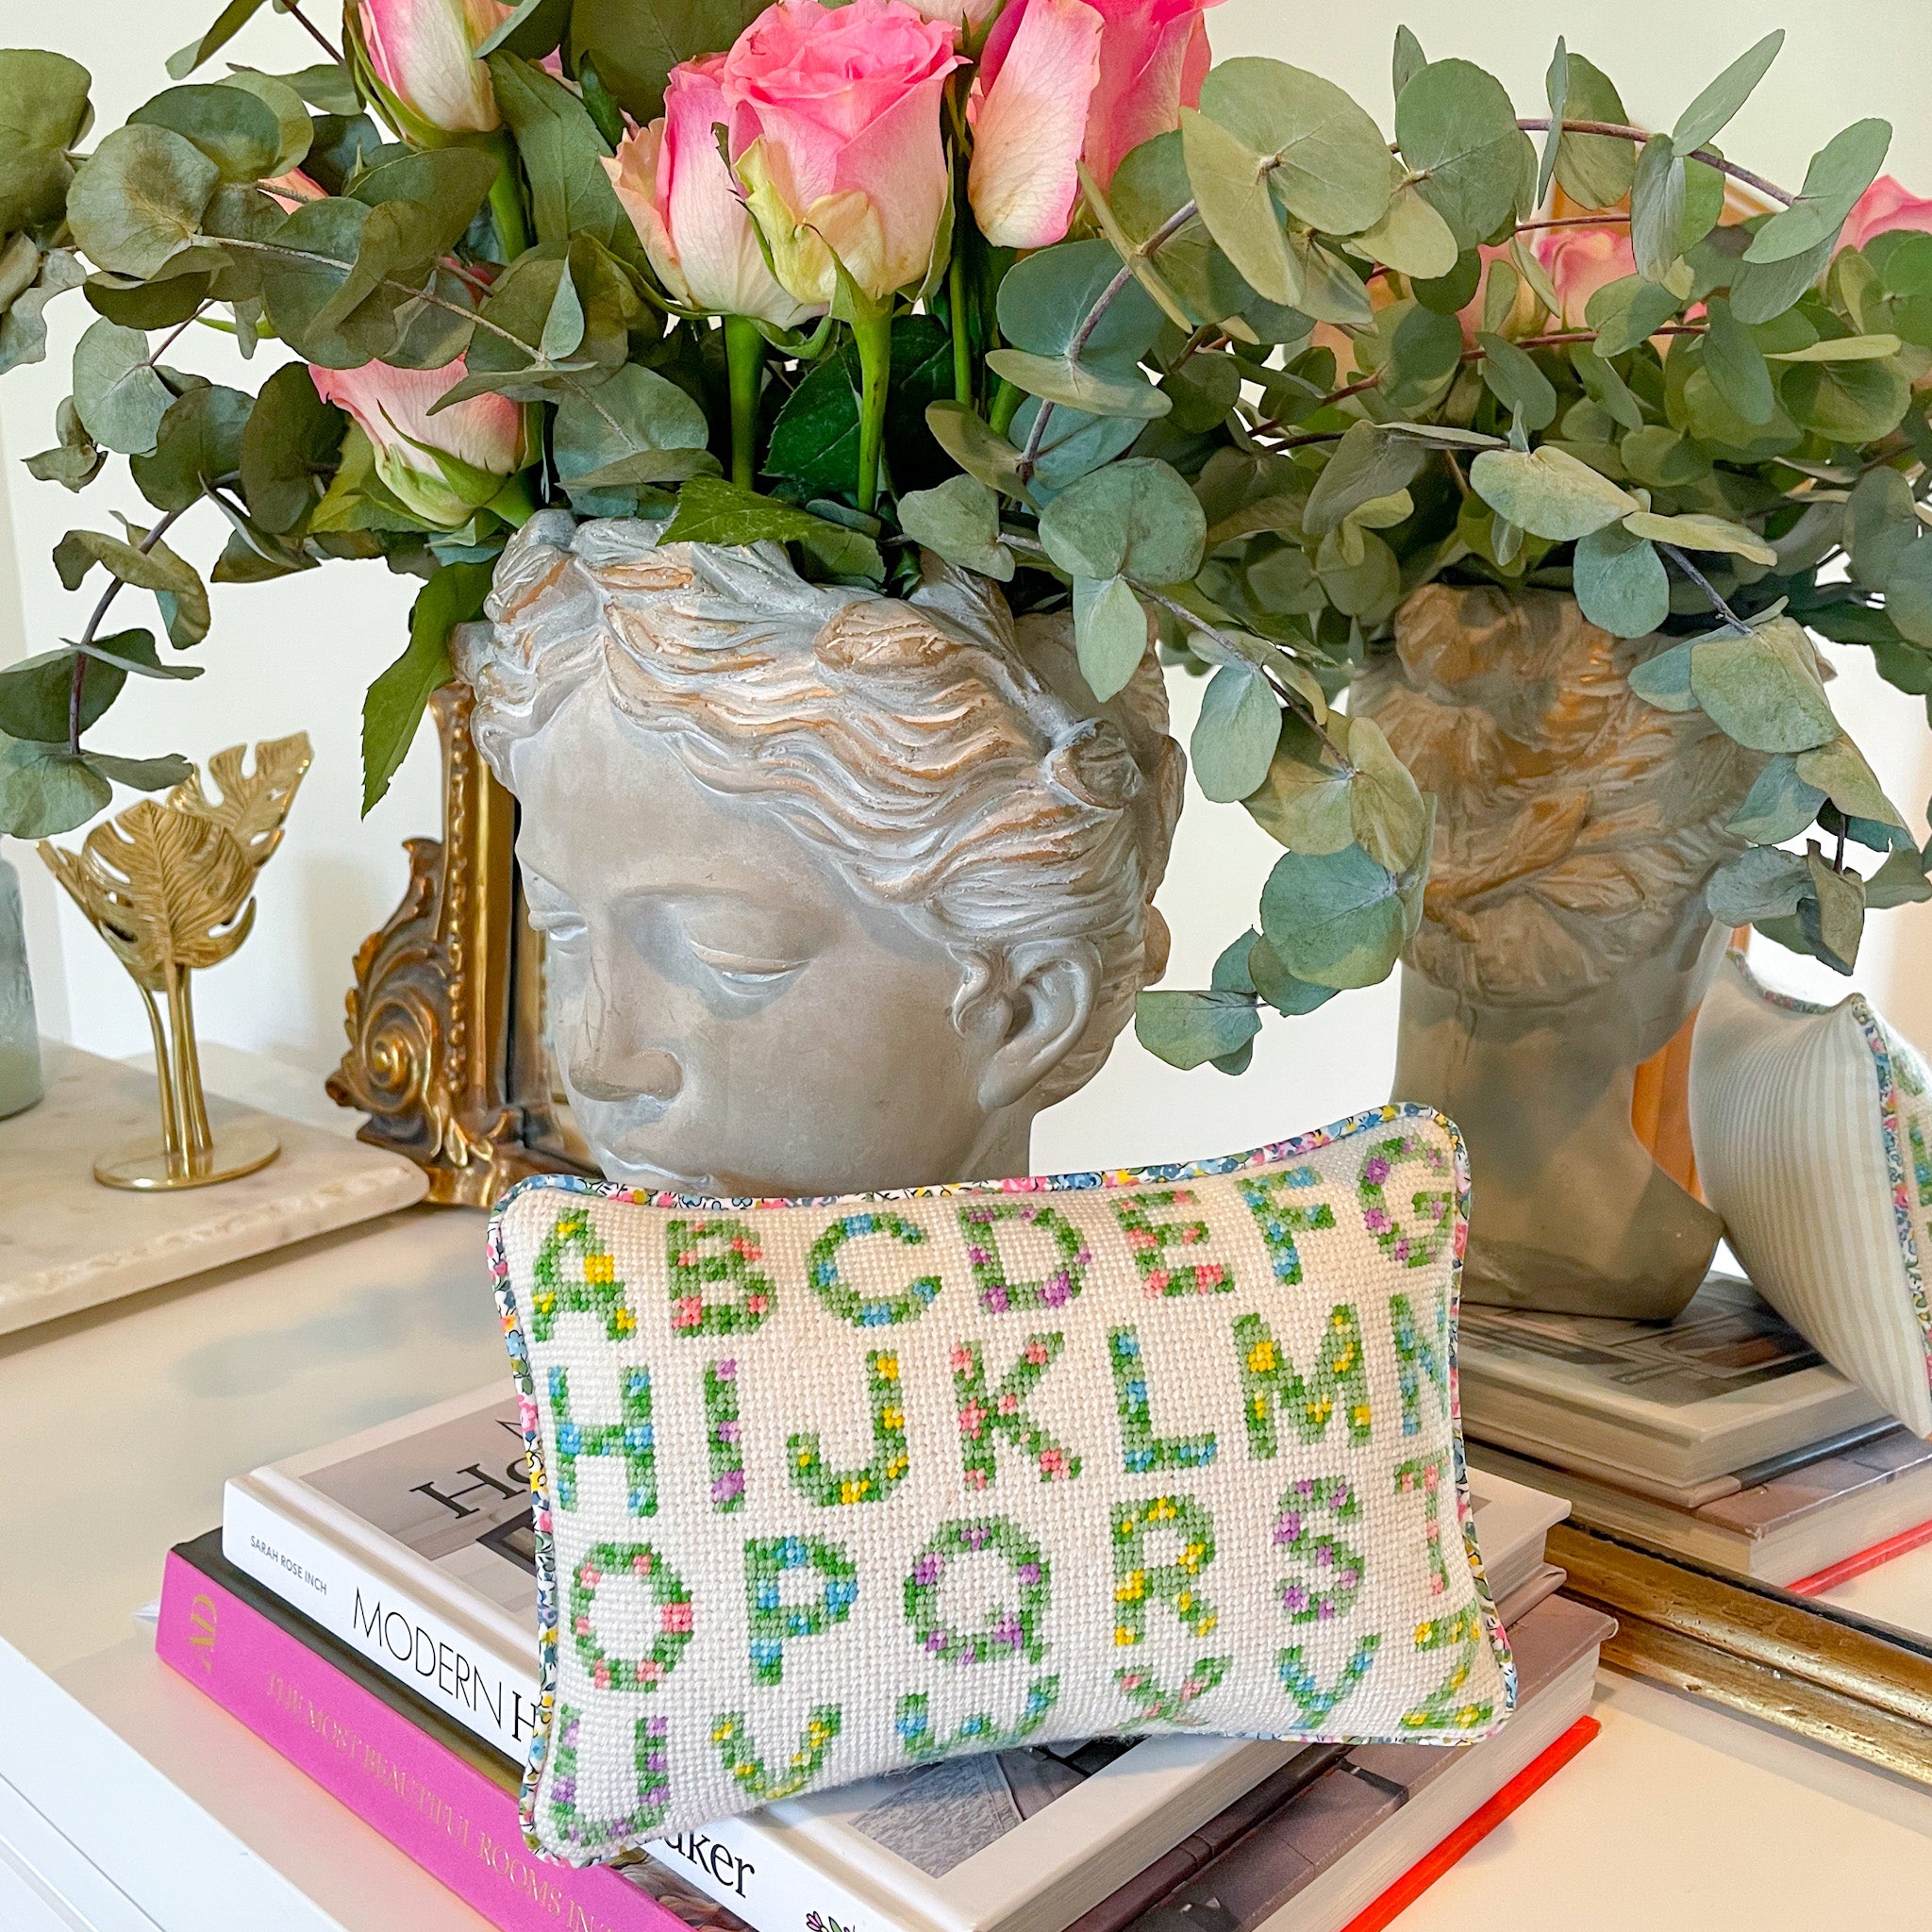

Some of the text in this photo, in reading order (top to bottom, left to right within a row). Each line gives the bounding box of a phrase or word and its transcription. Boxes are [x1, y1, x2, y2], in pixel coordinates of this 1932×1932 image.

[250, 1535, 327, 1595] SARAH ROSE INCH
[353, 1587, 502, 1728] MODERN
[308, 1700, 362, 1758] MOST
[363, 1744, 474, 1852] BEAUTIFUL
[479, 1831, 562, 1917] ROOMS
